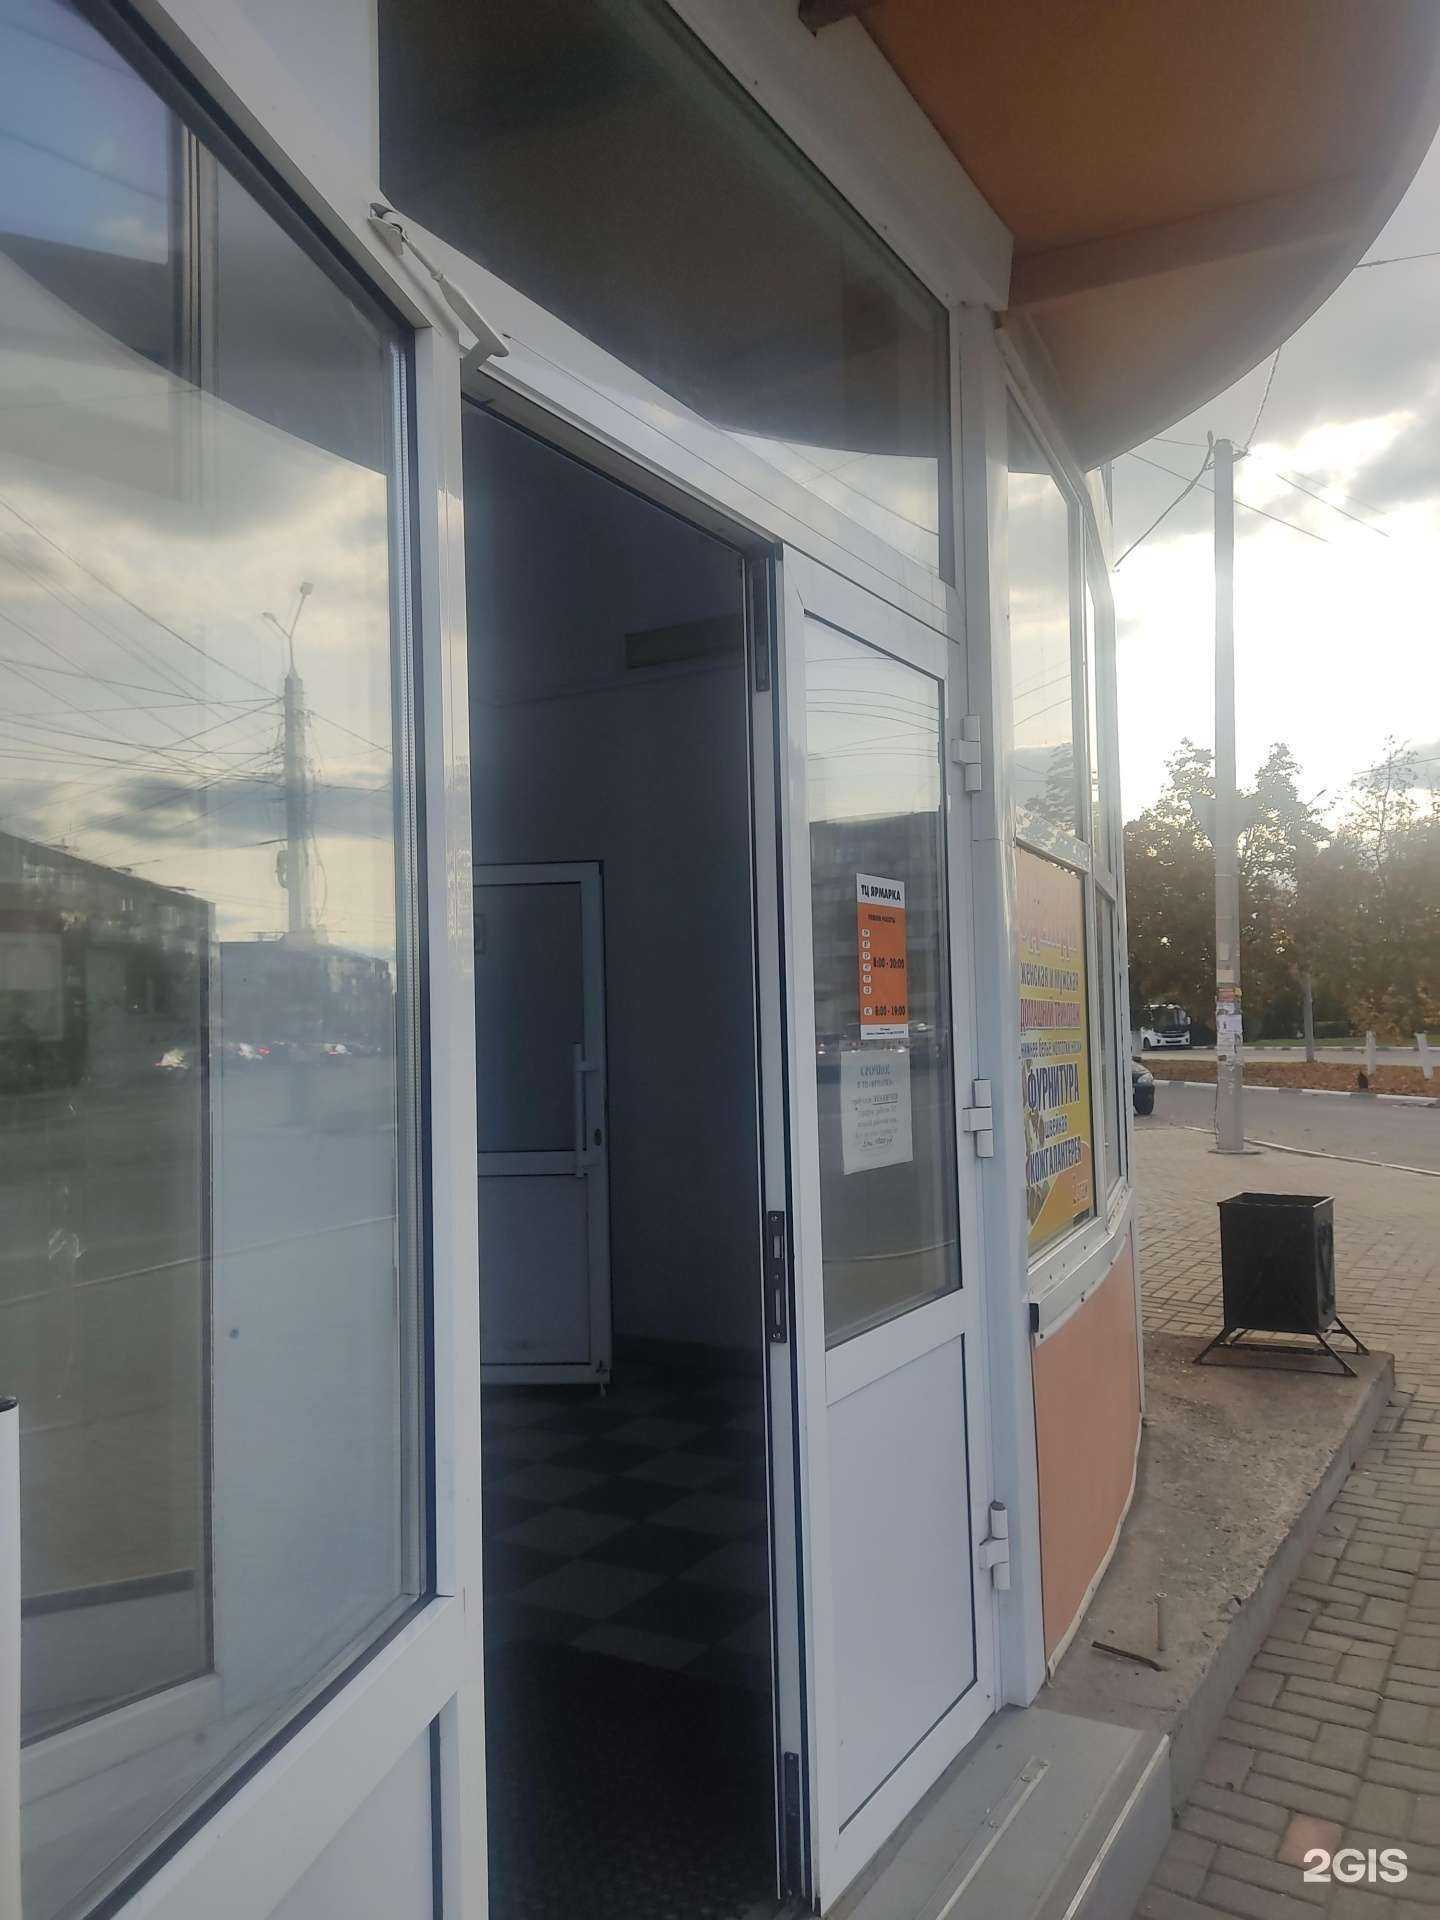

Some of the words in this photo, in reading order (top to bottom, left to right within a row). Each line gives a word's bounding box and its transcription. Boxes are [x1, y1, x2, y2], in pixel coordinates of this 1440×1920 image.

[861, 885, 869, 897] ТЦ
[871, 886, 901, 901] ЯРМАРКА
[1027, 1063, 1080, 1111] ФУРНИТУРА
[1030, 1136, 1081, 1184] КОЖГАЛАНТЕРЕЯ
